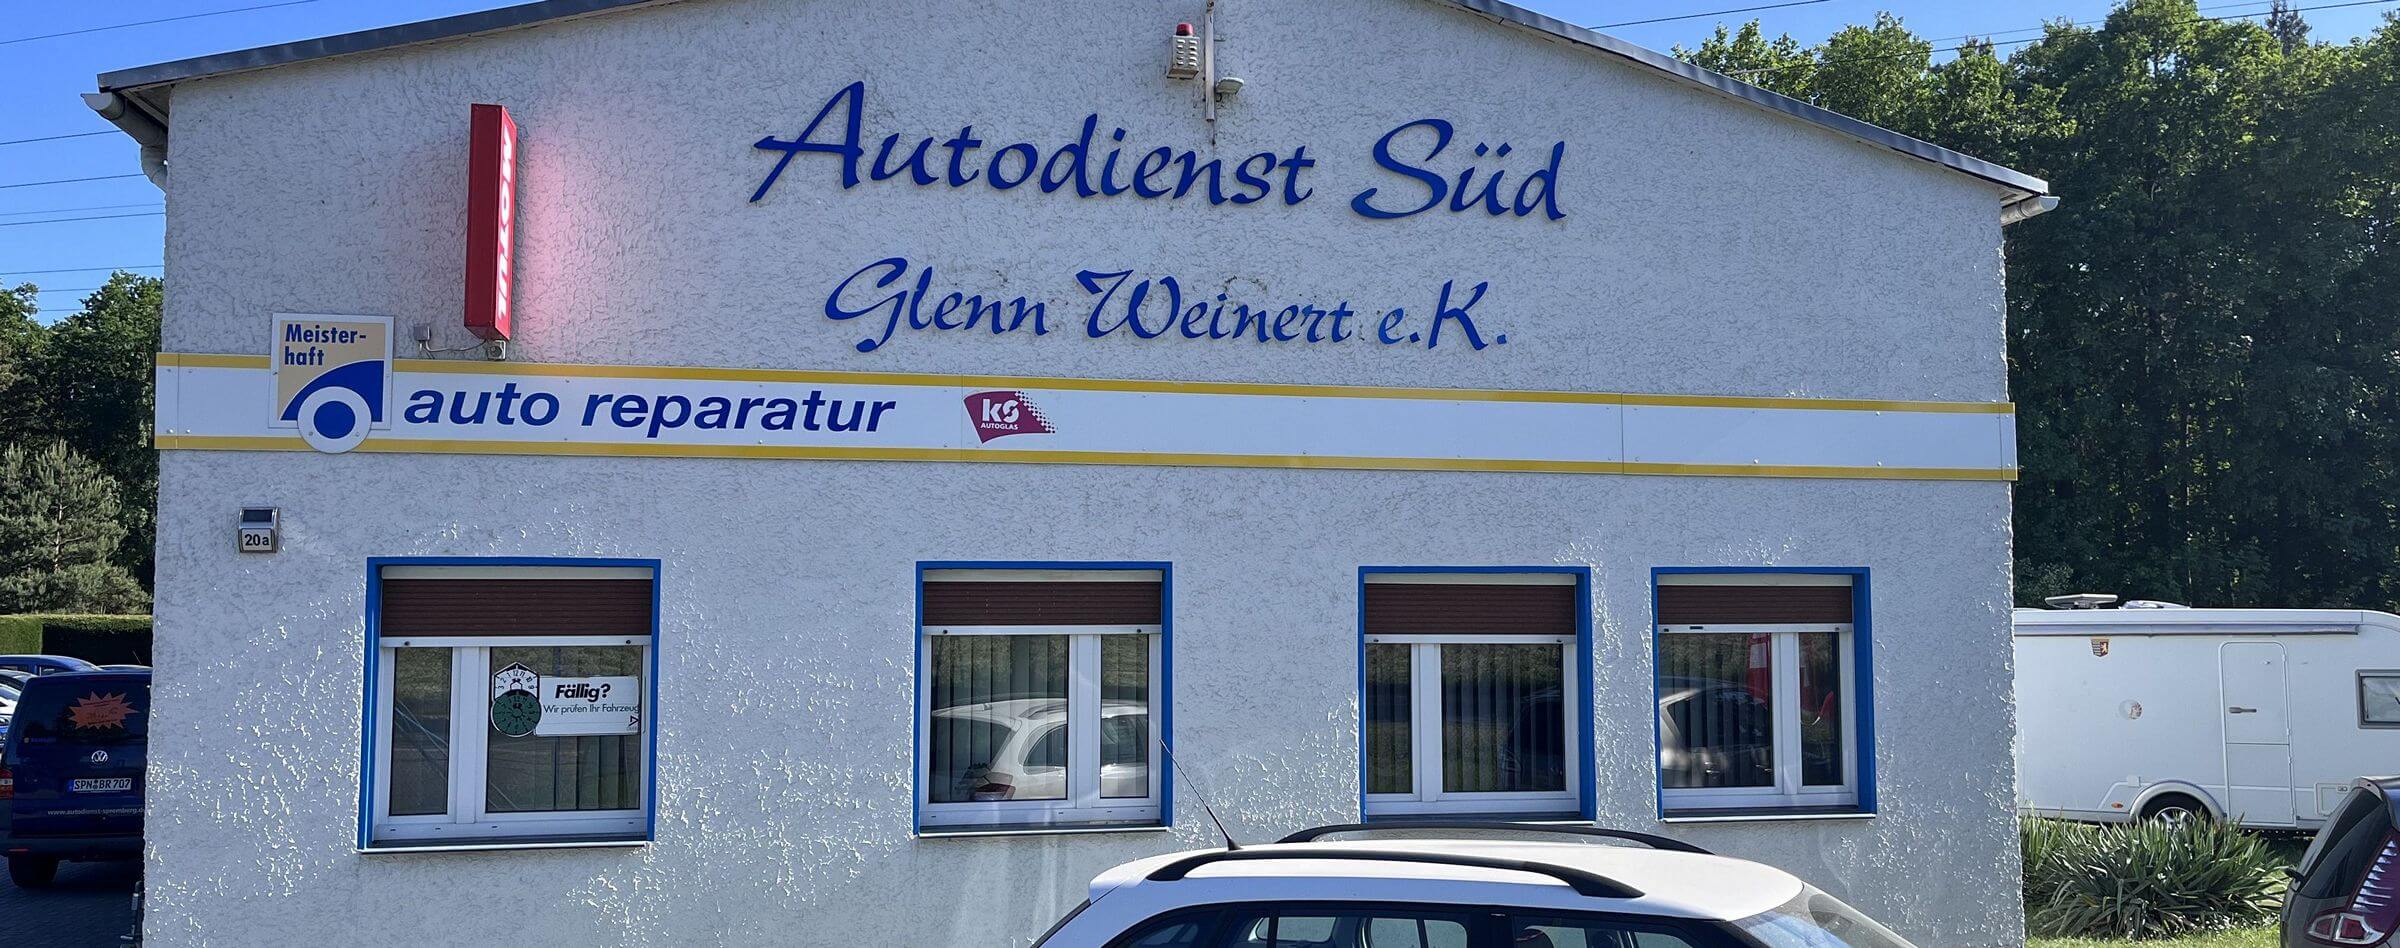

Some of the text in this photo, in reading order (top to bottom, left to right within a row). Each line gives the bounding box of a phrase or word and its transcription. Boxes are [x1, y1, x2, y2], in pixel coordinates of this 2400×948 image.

[751, 81, 1566, 220] Autodienst Süd
[497, 125, 512, 320] MOTUL
[825, 257, 1508, 352] Glenn Weinert e.K.
[285, 323, 367, 344] Meister-
[284, 346, 325, 366] haft
[403, 382, 896, 438] auto reparatur
[980, 422, 1019, 430] AUTOGLAS
[244, 533, 270, 546] 20a
[555, 683, 611, 703] Fällig?
[543, 704, 560, 713] Wir
[561, 703, 588, 715] prüfen
[589, 703, 600, 713] Ihr
[74, 778, 131, 790] SPN BR 707
